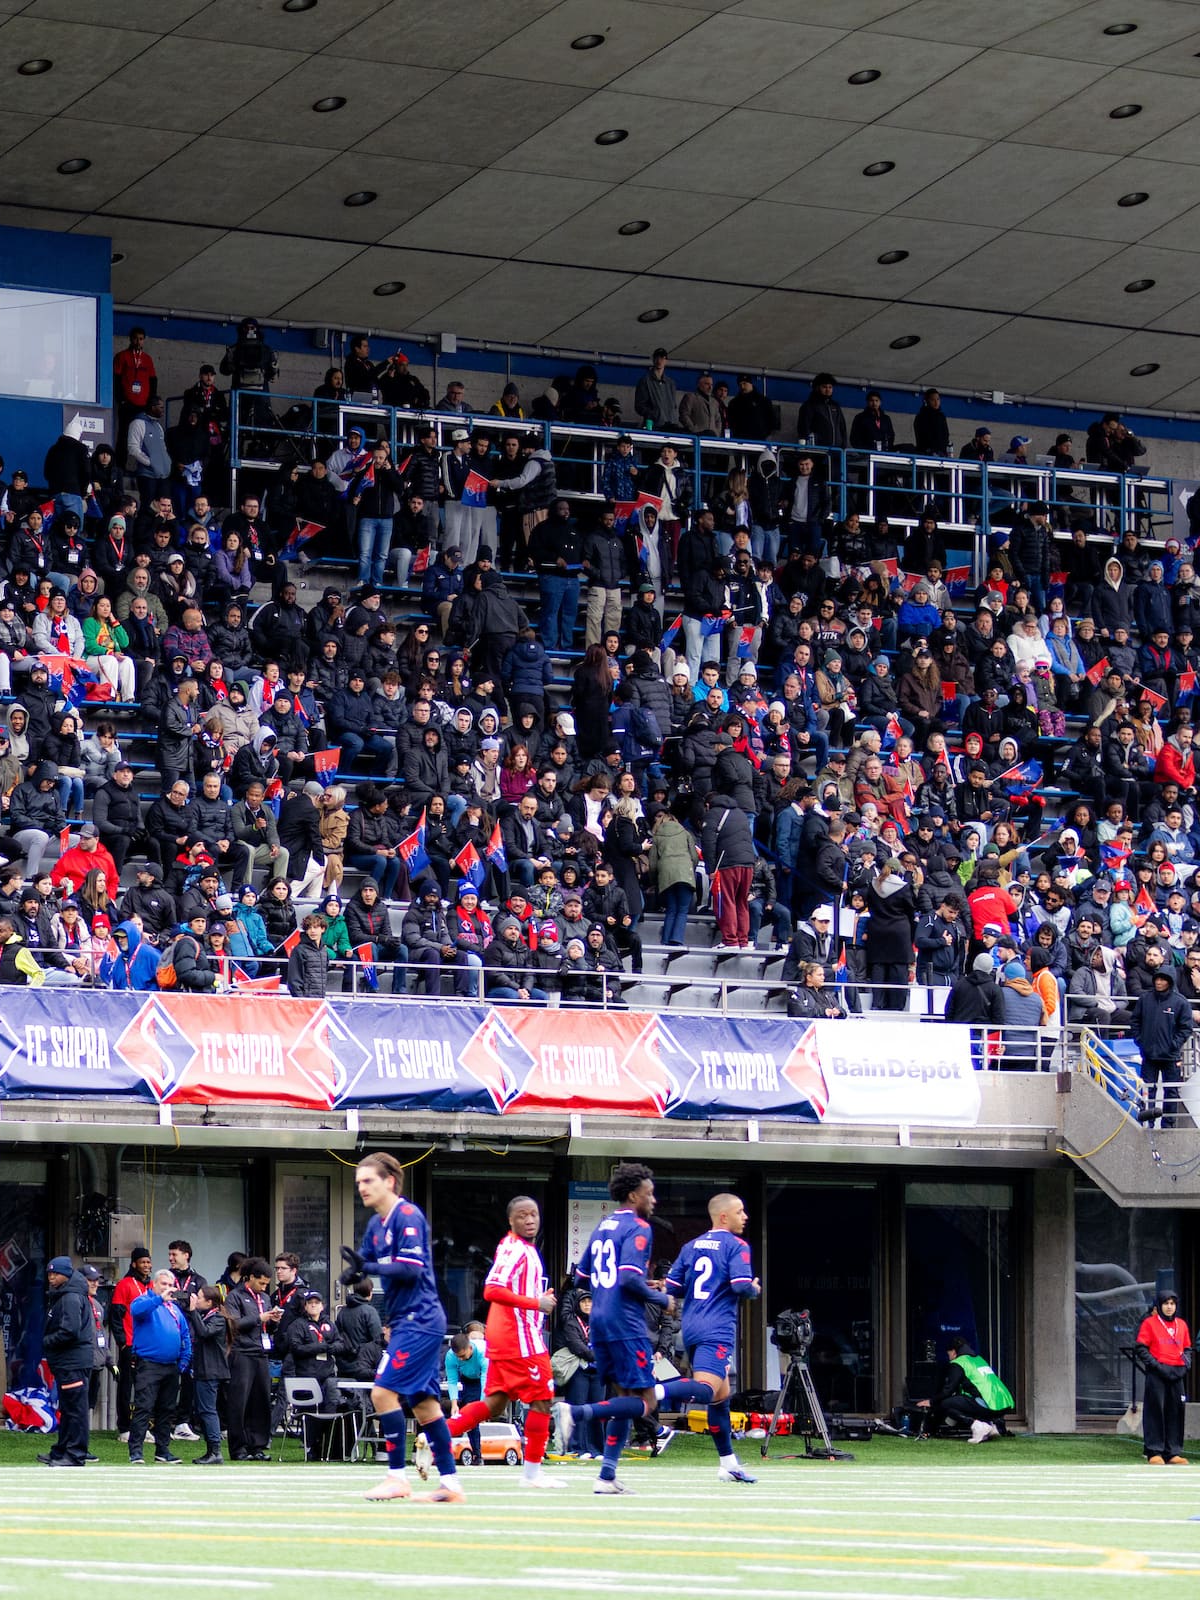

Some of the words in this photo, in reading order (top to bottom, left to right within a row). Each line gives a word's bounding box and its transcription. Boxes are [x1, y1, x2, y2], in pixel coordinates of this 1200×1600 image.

[25, 1024, 47, 1067] FC
[50, 1026, 111, 1069] SUPRA
[201, 1032, 224, 1074] FC
[226, 1033, 285, 1076] SUPRA
[373, 1038, 397, 1078] FC
[397, 1039, 459, 1079] SUPRA
[540, 1044, 561, 1084] FC
[562, 1045, 620, 1086] SUPRA
[701, 1051, 723, 1089] FC
[723, 1052, 780, 1092] SUPRA
[832, 1057, 962, 1083] BainDépôt
[590, 1239, 617, 1288] 33
[694, 1256, 713, 1300] 2
